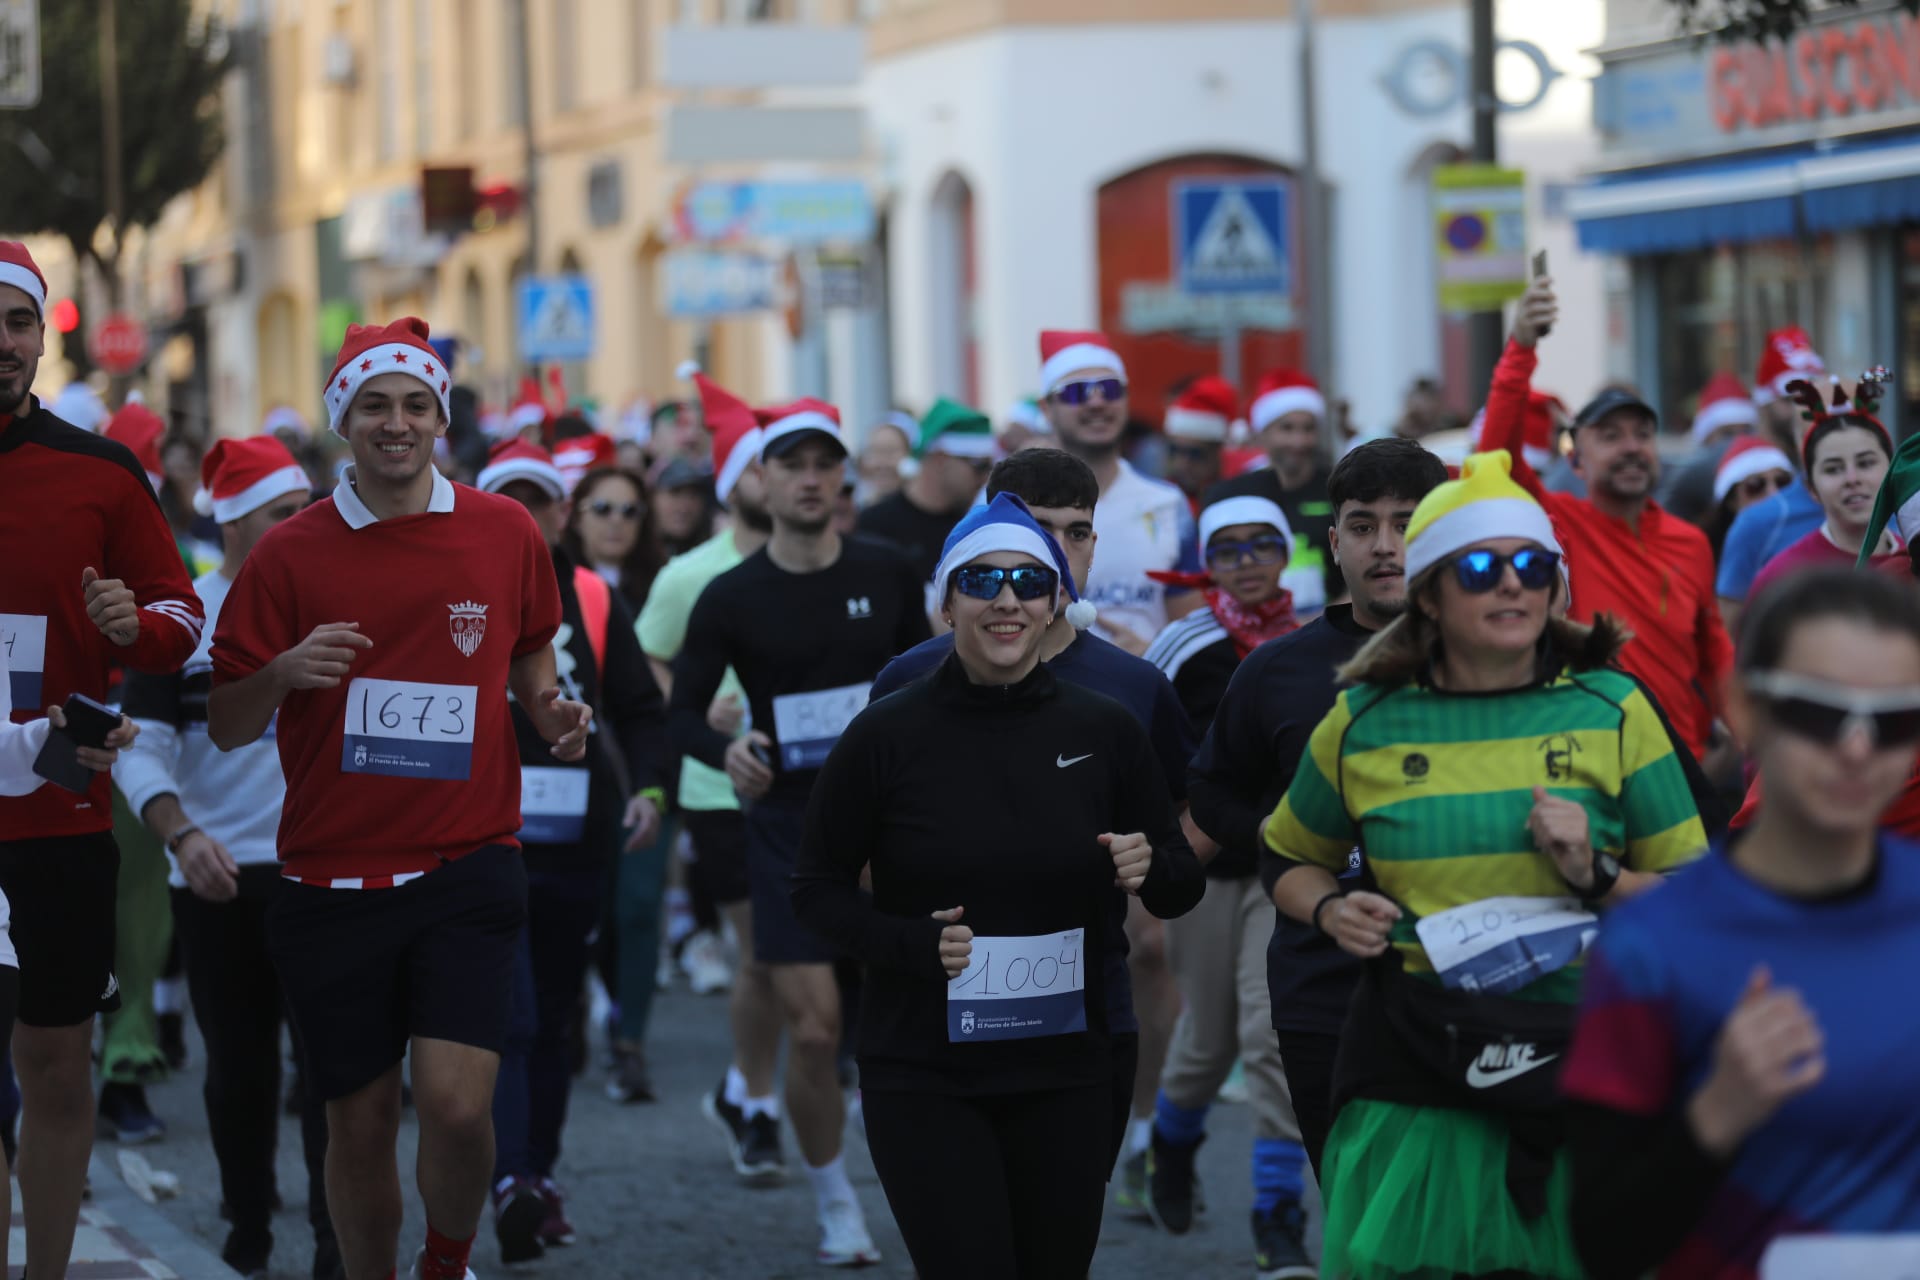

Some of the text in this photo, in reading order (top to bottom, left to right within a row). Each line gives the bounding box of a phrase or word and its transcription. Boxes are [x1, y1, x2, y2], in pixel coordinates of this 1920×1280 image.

[363, 688, 464, 735] 1673
[956, 948, 1077, 995] 1004
[1480, 1043, 1537, 1069] NIKE
